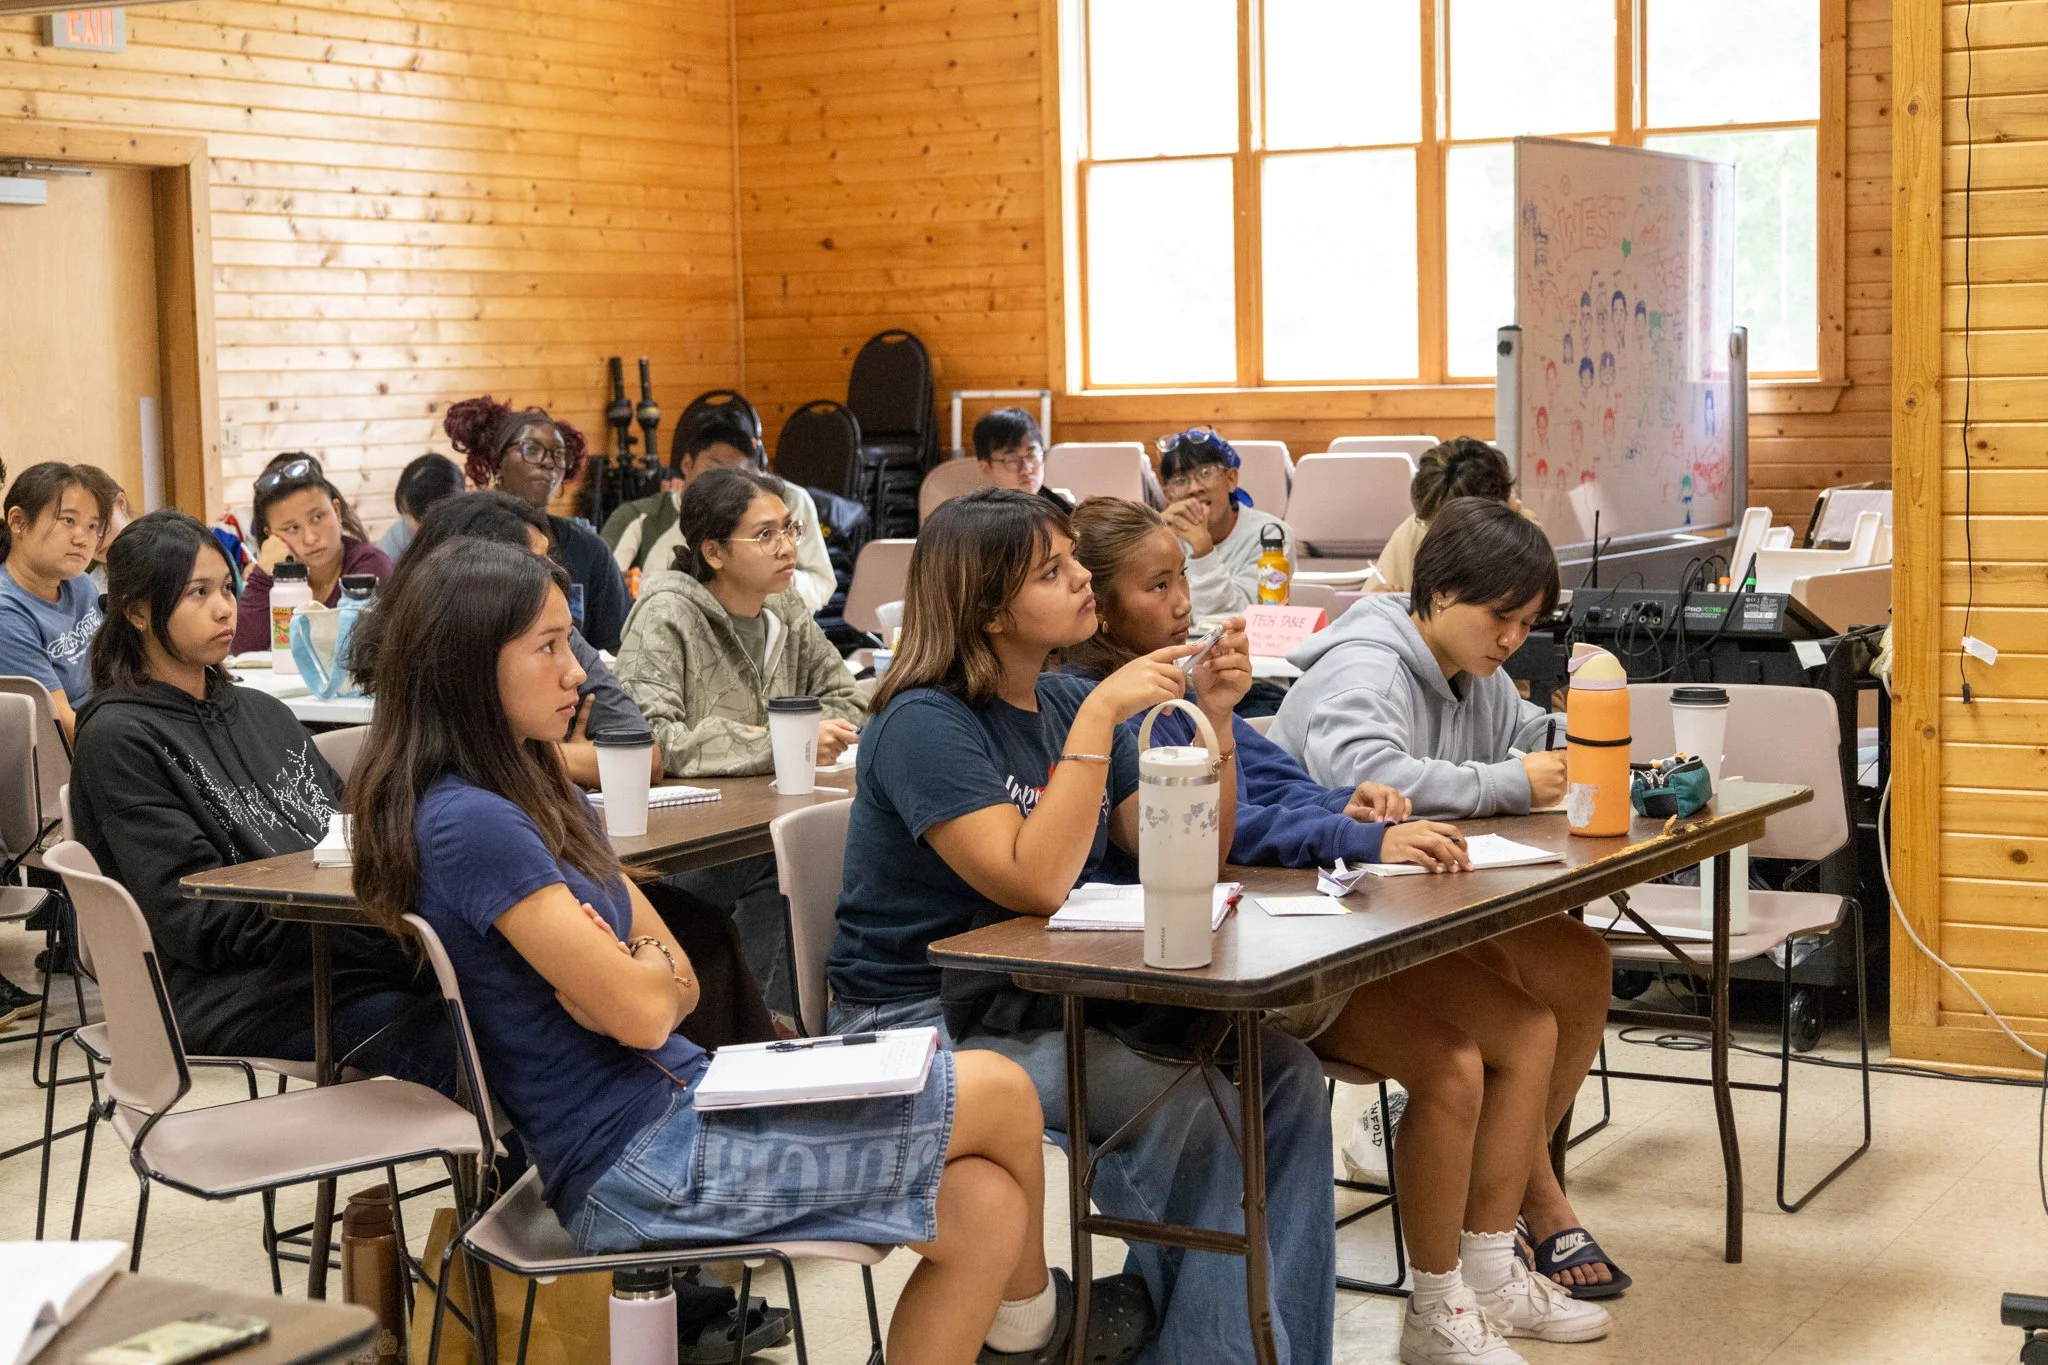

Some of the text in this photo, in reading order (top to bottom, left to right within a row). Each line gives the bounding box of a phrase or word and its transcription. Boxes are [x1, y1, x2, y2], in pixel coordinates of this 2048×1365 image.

[66, 8, 114, 45] EXIT
[1252, 613, 1308, 629] TECH TABLE
[1555, 1232, 1585, 1253] NIKE
